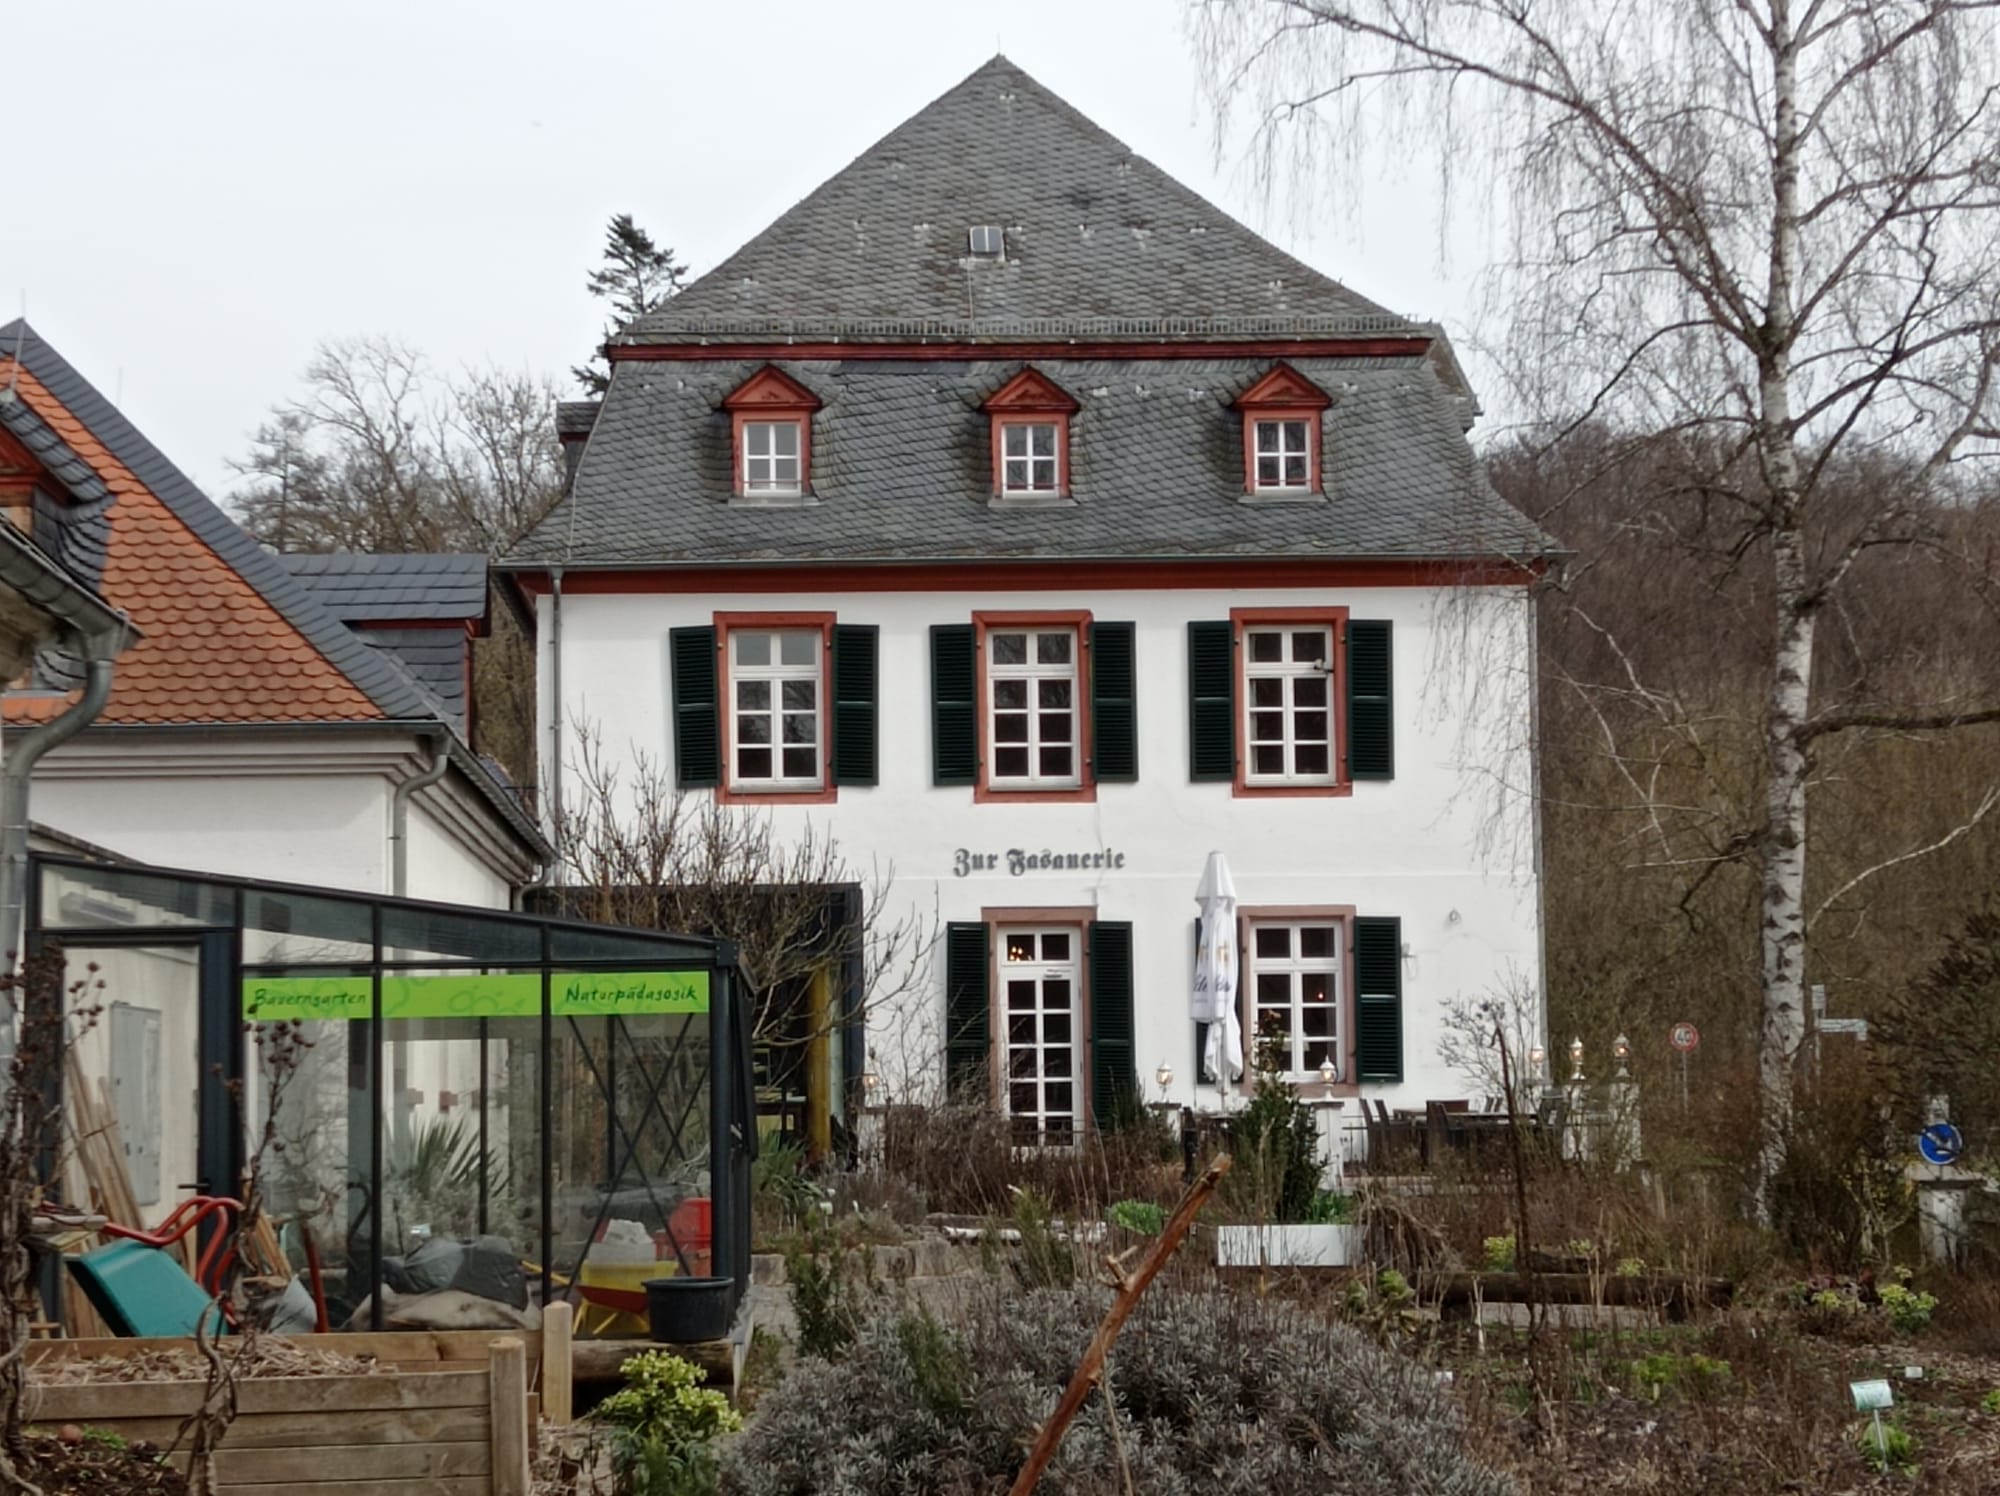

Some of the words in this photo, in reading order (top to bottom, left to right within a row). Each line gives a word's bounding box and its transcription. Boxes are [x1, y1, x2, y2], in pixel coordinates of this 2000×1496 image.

[953, 848, 998, 877] Zur
[1006, 848, 1125, 877] Fasanerie
[254, 988, 366, 1007] Bauerngarten
[565, 983, 697, 1004] Naturpädagogik
